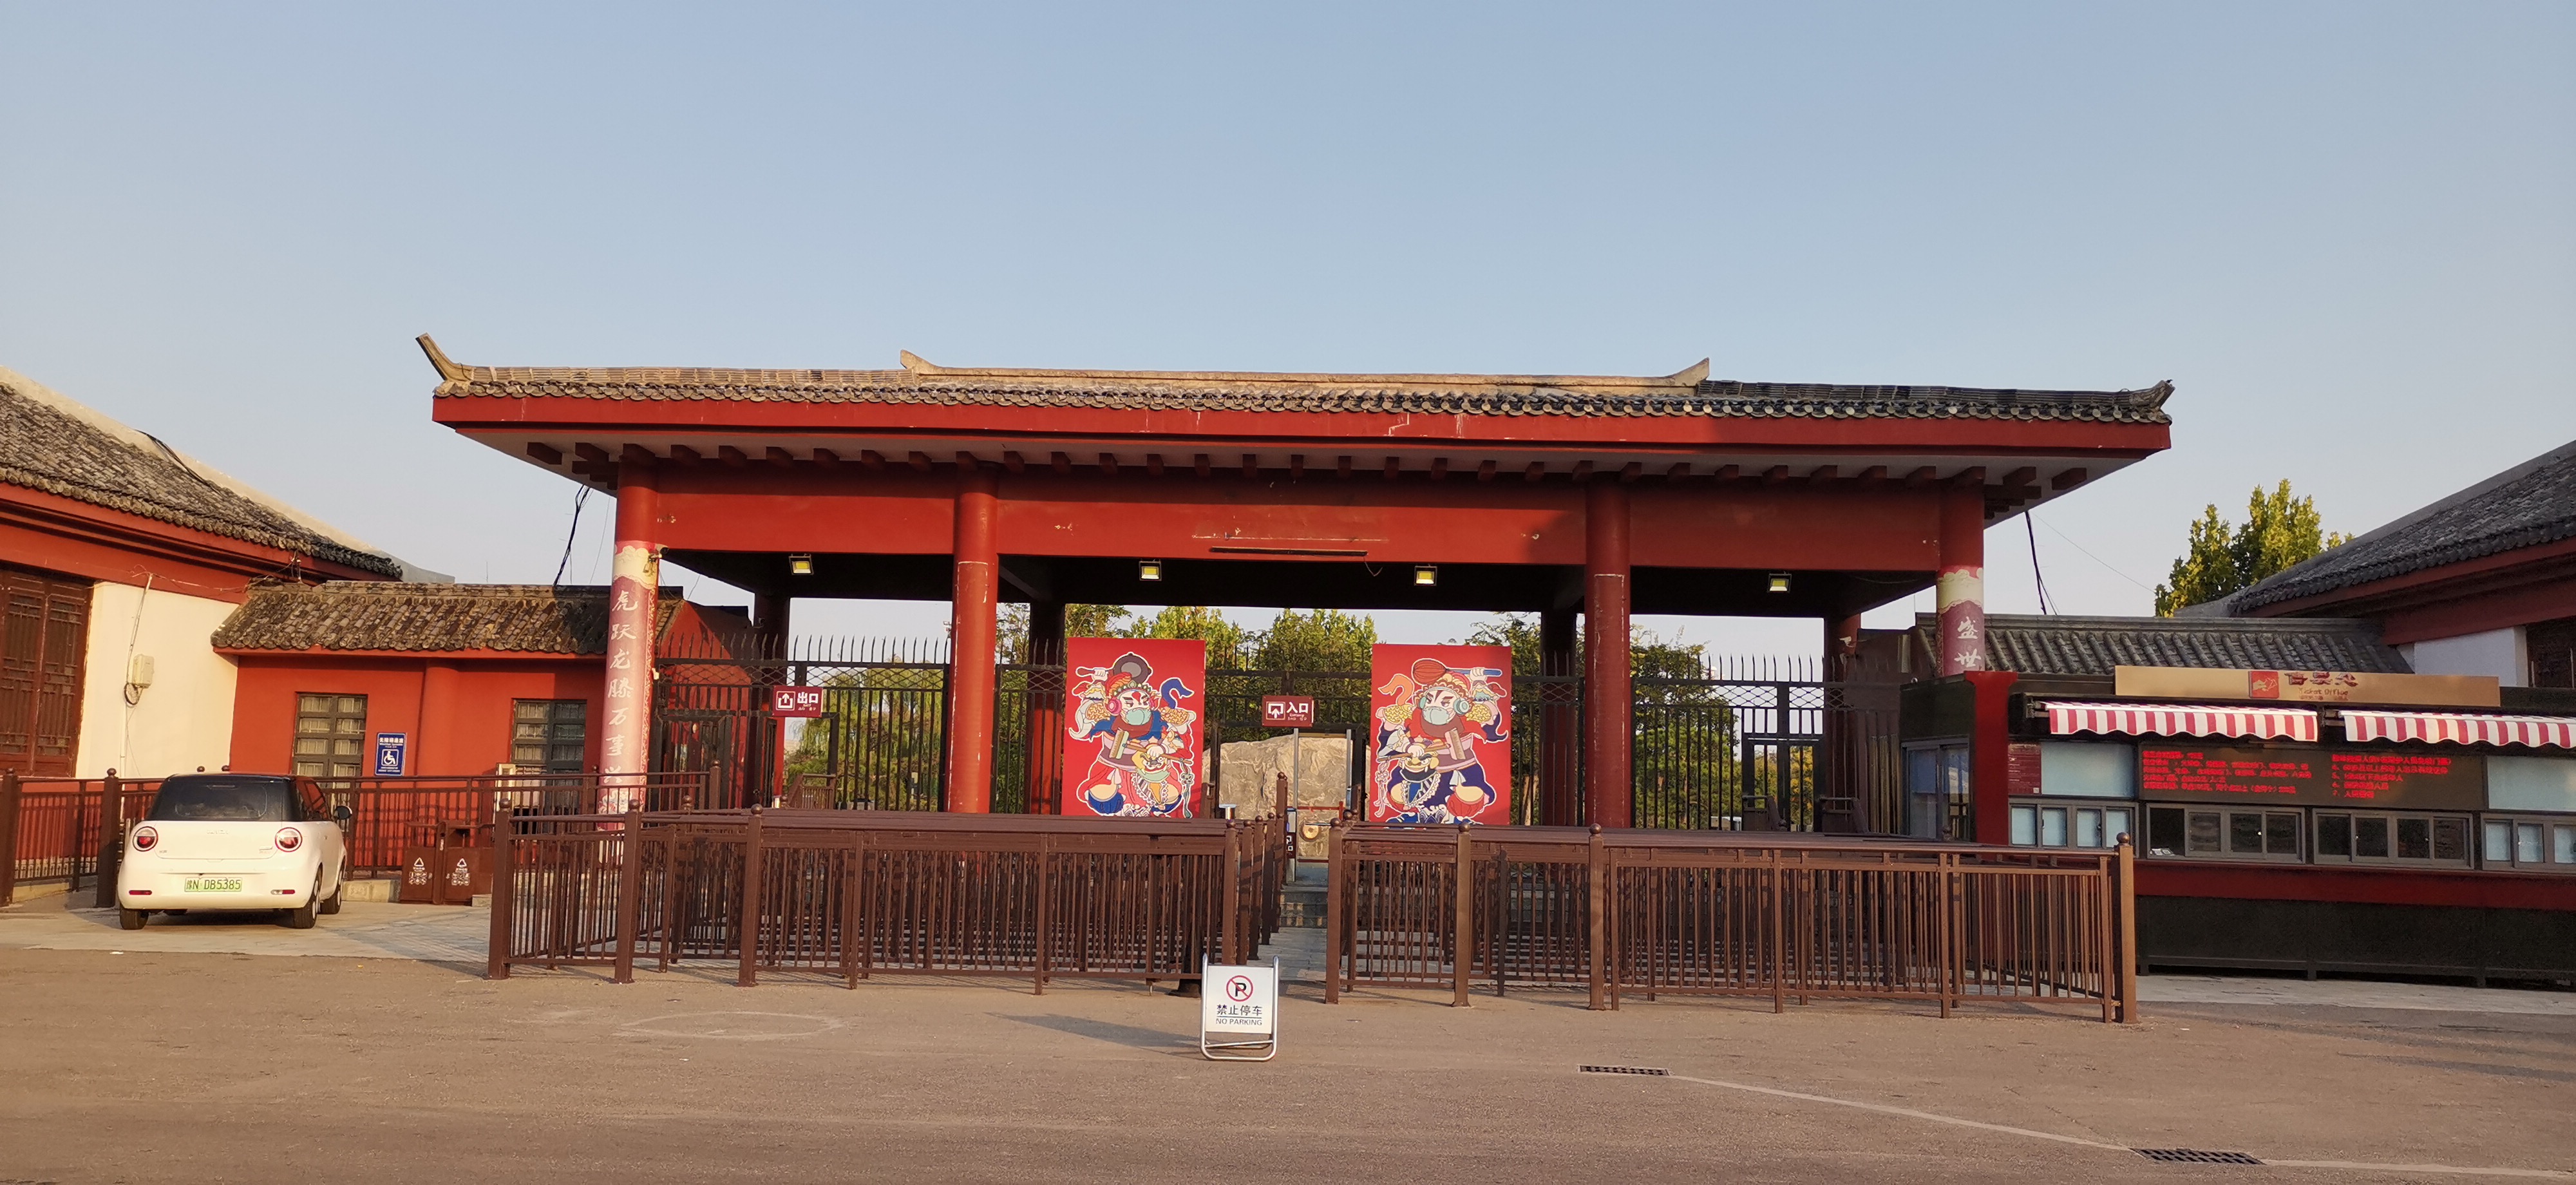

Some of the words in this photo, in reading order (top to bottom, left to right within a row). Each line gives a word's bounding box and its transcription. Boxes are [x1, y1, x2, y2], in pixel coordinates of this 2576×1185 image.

[1953, 616, 1982, 668] 盛世
[797, 691, 819, 704] 出口
[1286, 701, 1309, 714] 入口
[204, 879, 242, 890] DB5385
[1217, 1004, 1263, 1017] 禁止停车
